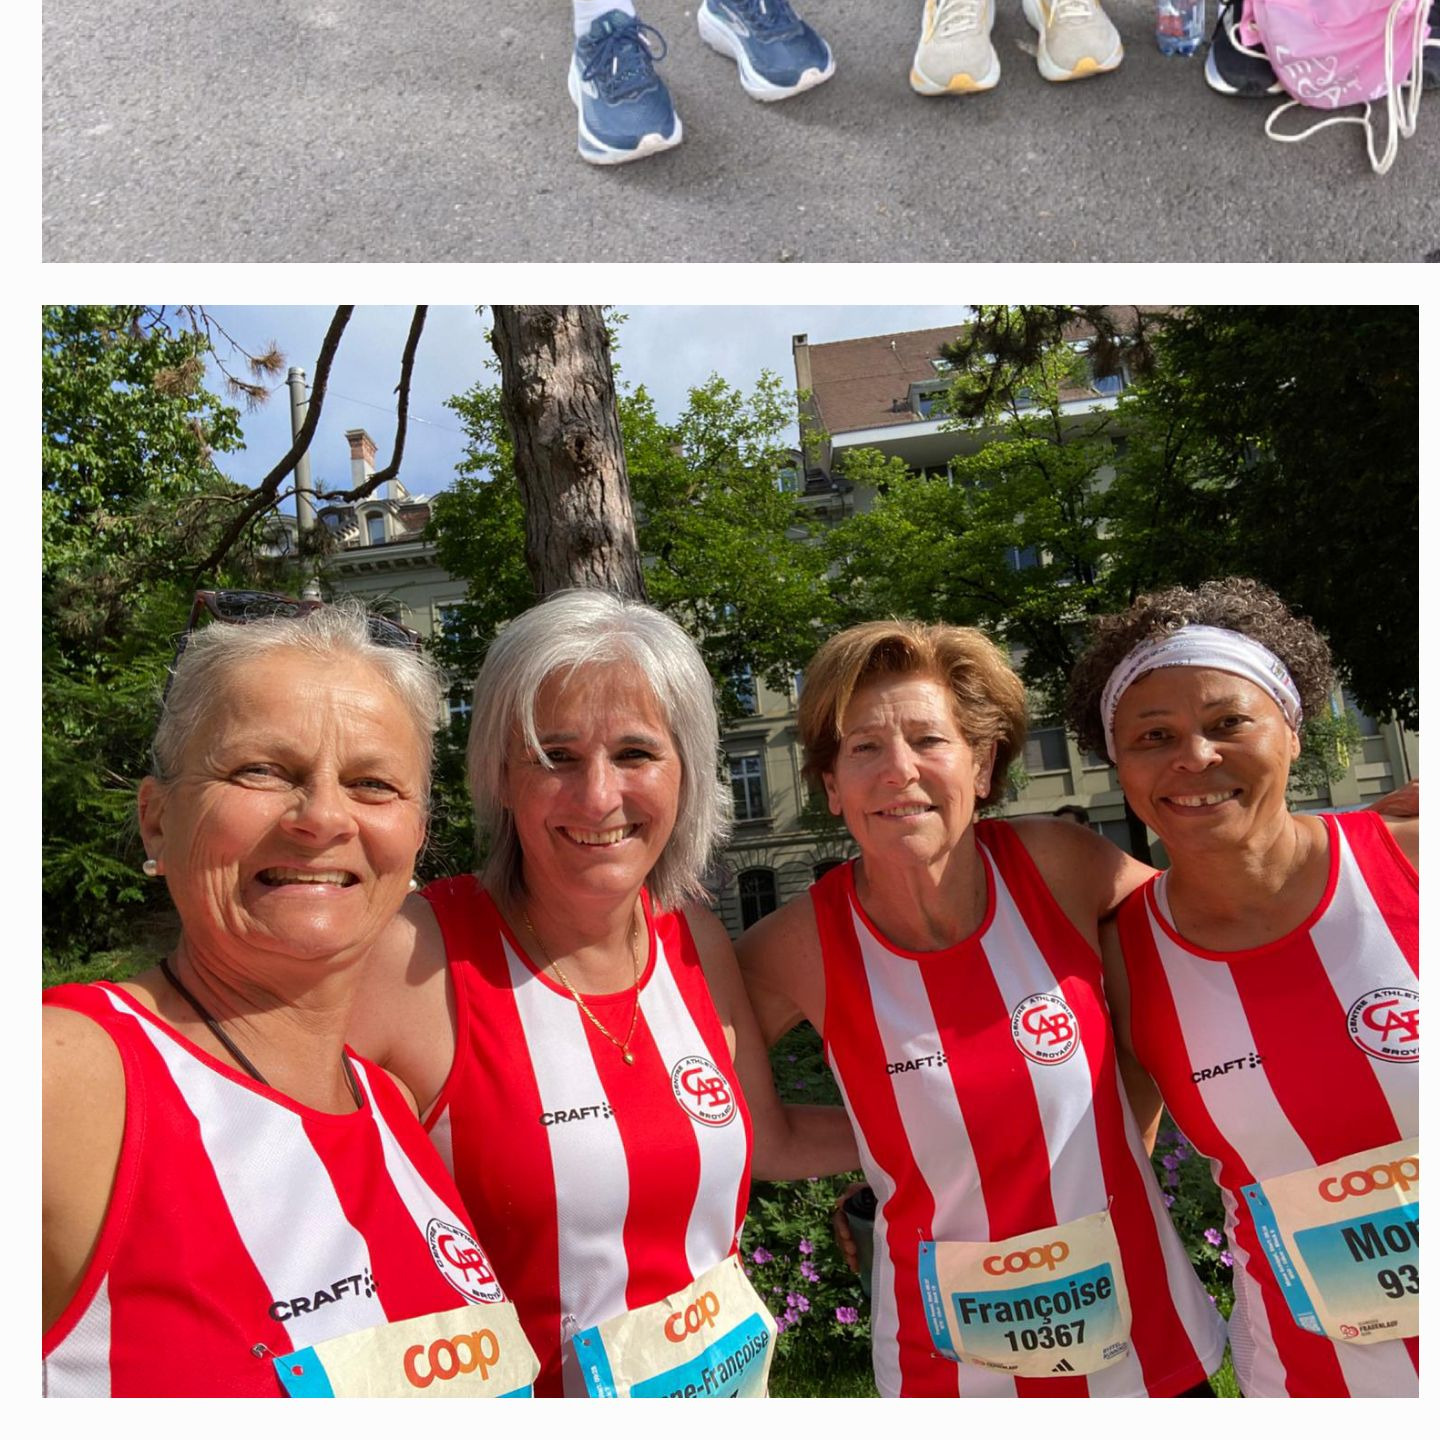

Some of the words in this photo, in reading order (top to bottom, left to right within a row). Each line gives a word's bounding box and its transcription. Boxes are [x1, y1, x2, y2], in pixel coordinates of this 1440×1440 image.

[1374, 990, 1419, 1000] ATHLET
[1022, 1004, 1074, 1047] CAB
[886, 1056, 935, 1075] CRAFT
[1381, 1047, 1419, 1056] BROY
[681, 1067, 731, 1108] CAB
[1191, 1057, 1247, 1084] CRAFT
[538, 1105, 600, 1127] CRAFT
[1318, 1156, 1419, 1203] coop
[982, 1241, 1070, 1276] coop
[268, 1273, 364, 1322] CRAFT
[958, 1275, 1112, 1325] Françoise
[1004, 1319, 1086, 1352] 10367
[403, 1328, 500, 1389] coop
